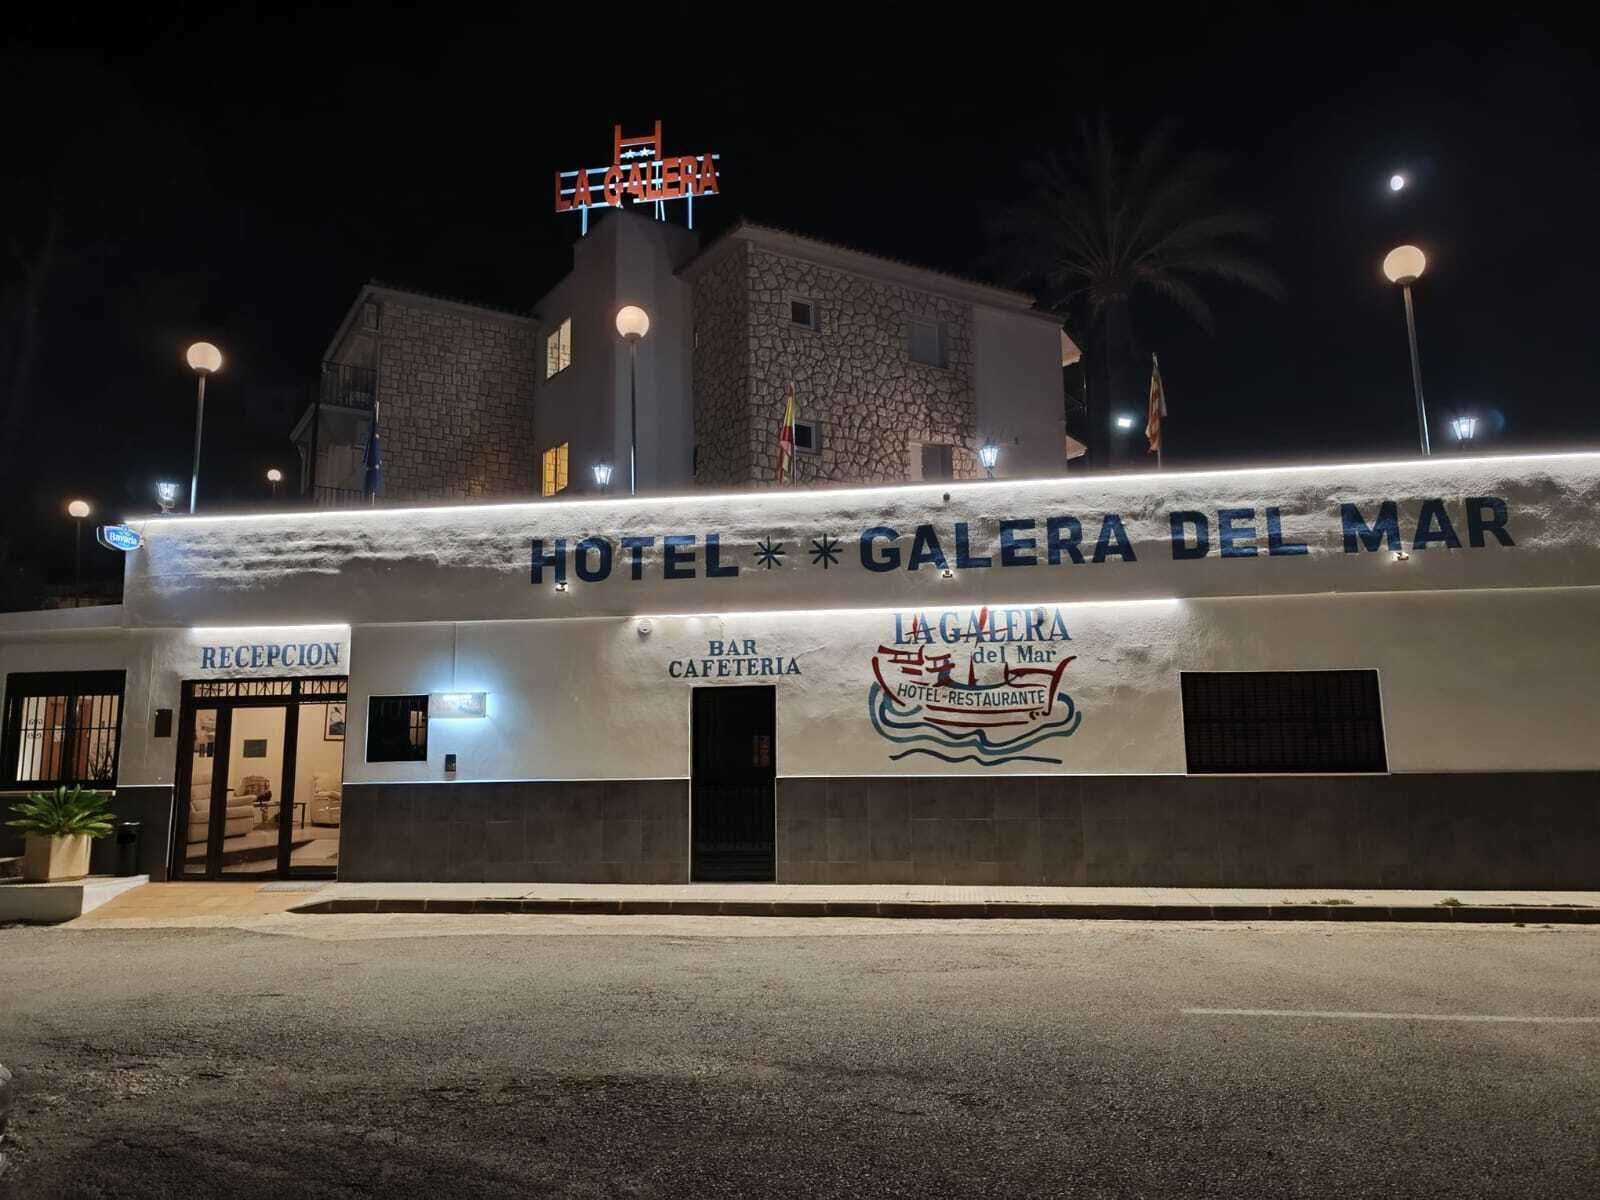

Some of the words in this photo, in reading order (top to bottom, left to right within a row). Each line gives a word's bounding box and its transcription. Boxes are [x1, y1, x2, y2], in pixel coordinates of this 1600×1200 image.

[555, 167, 592, 212] LA
[603, 152, 720, 206] GALERA
[530, 533, 739, 585] HOTEL
[859, 513, 1138, 573] GALERA
[1169, 506, 1309, 561] DEL
[1340, 496, 1516, 554] MAR
[893, 611, 937, 645] LA
[938, 606, 1073, 644] GALERA
[200, 642, 341, 669] RECEPCION
[708, 639, 758, 657] BAR
[972, 645, 1007, 664] del
[1016, 645, 1057, 664] Mar
[668, 656, 802, 678] CAFETERIA
